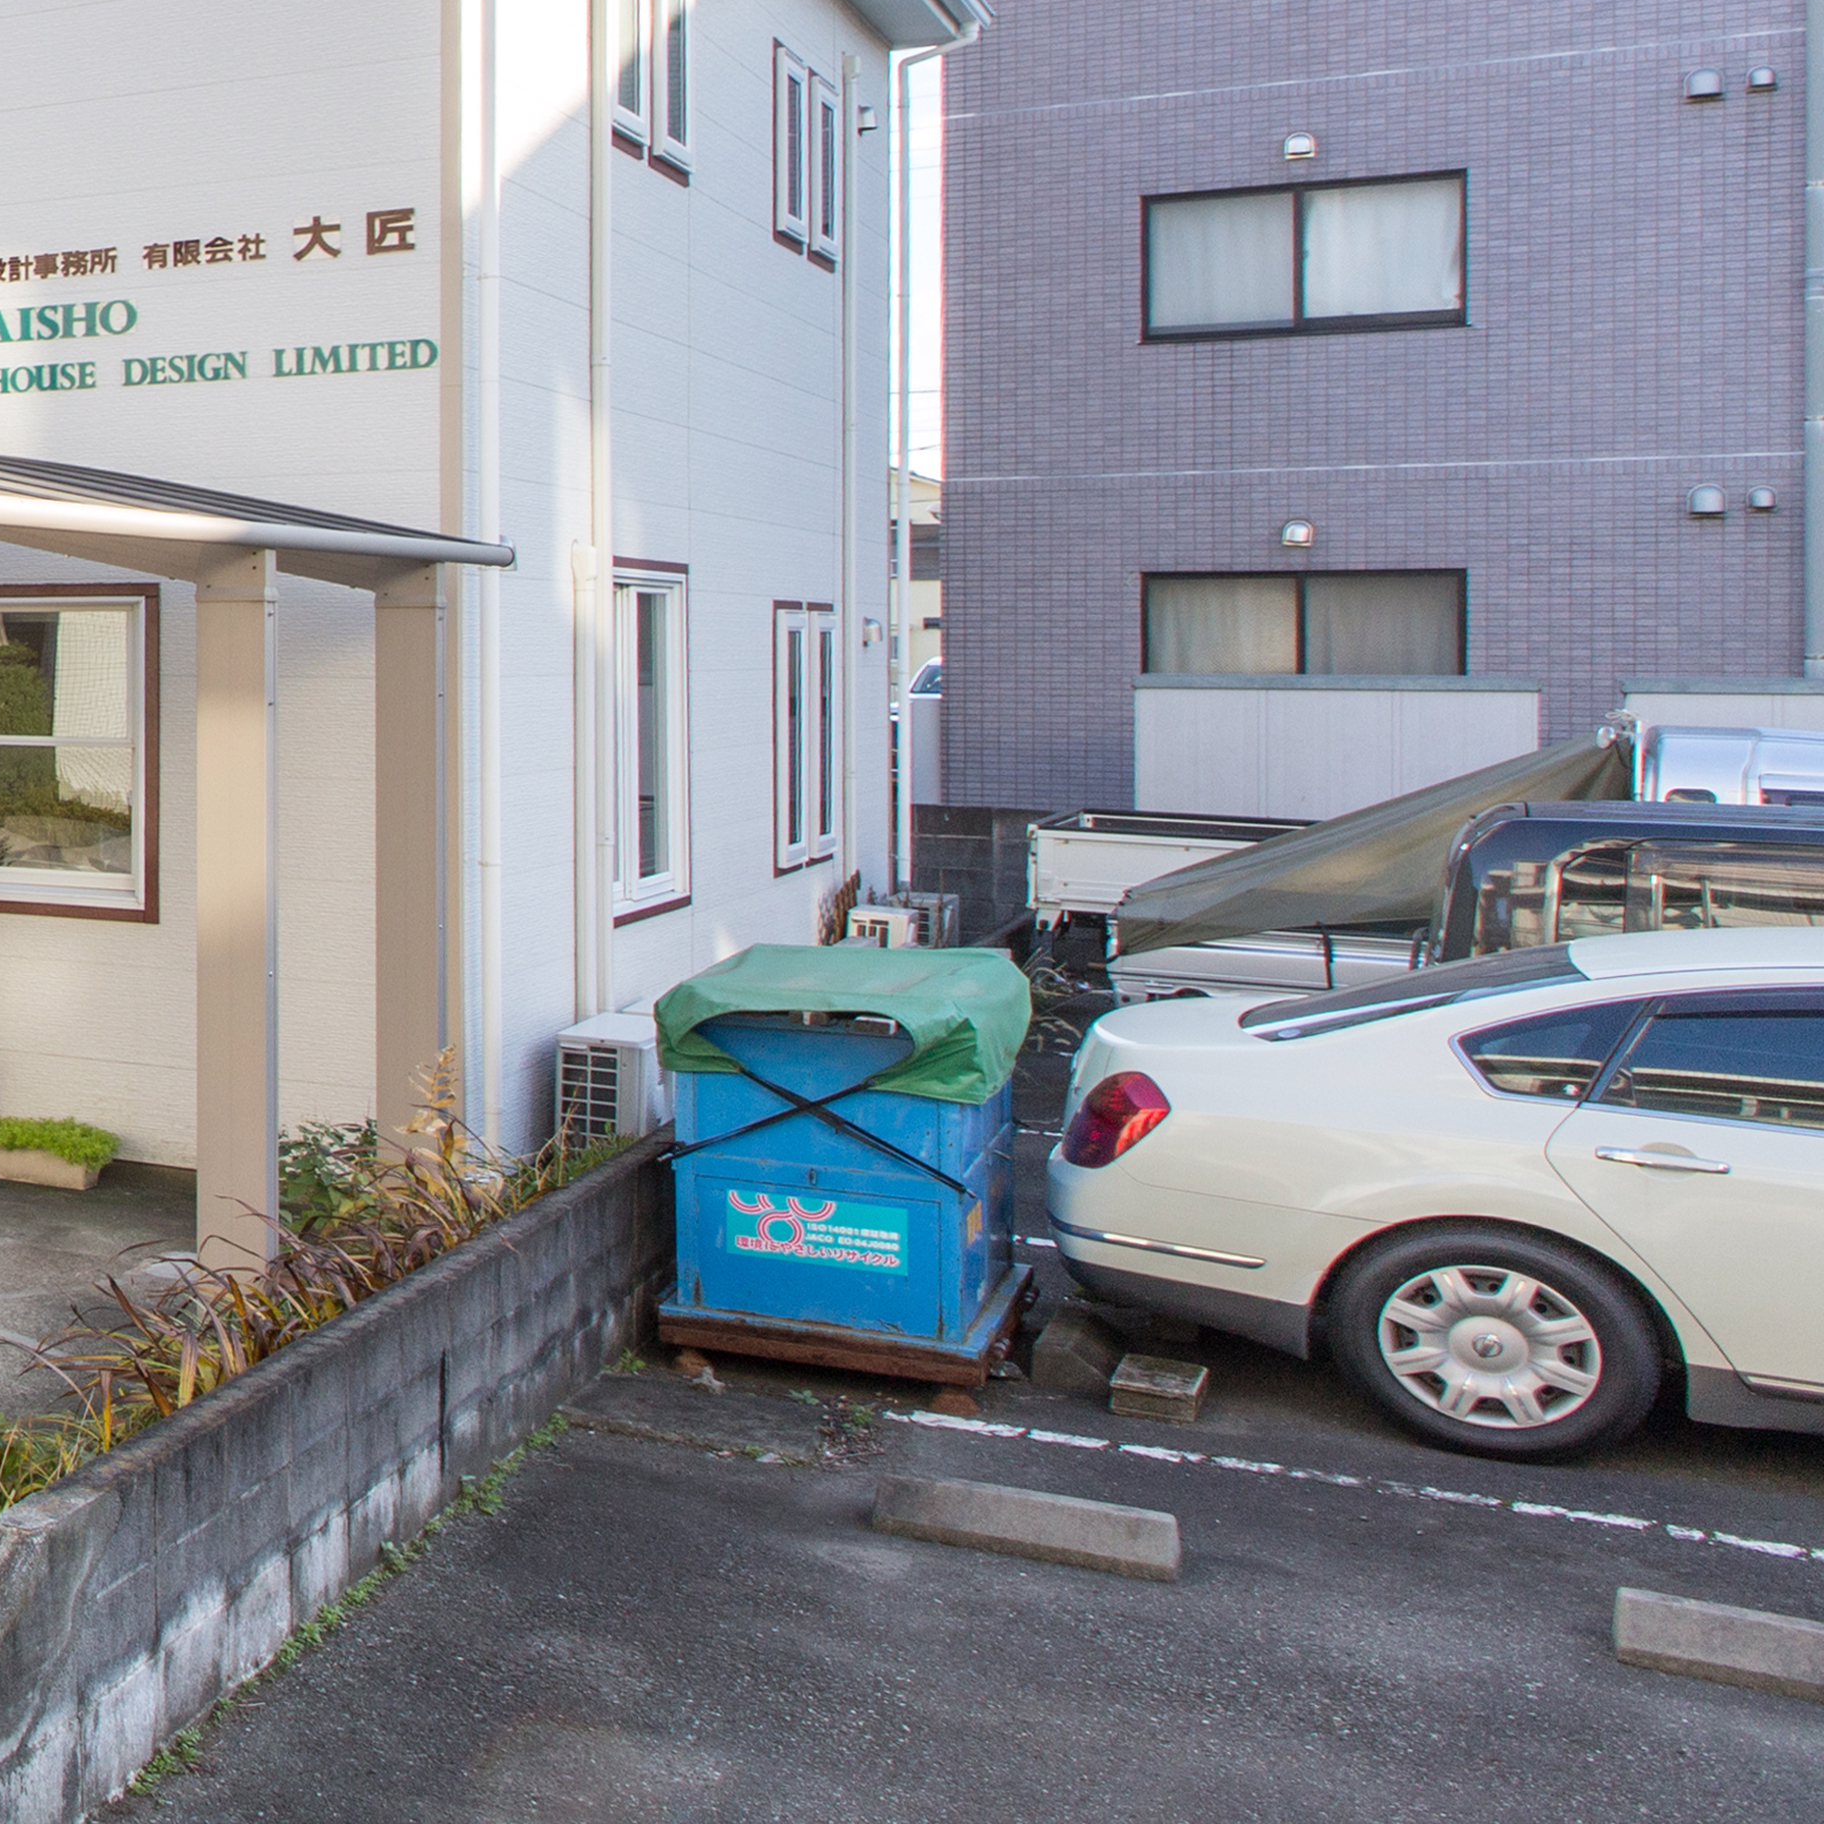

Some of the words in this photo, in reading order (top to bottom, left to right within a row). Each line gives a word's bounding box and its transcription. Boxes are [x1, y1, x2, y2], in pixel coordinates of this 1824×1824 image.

[143, 232, 267, 271] 有限会社
[121, 351, 248, 387] DESIGN
[272, 338, 439, 378] LIMITED
[735, 1235, 901, 1268] 環境にやさしいリサイクル
